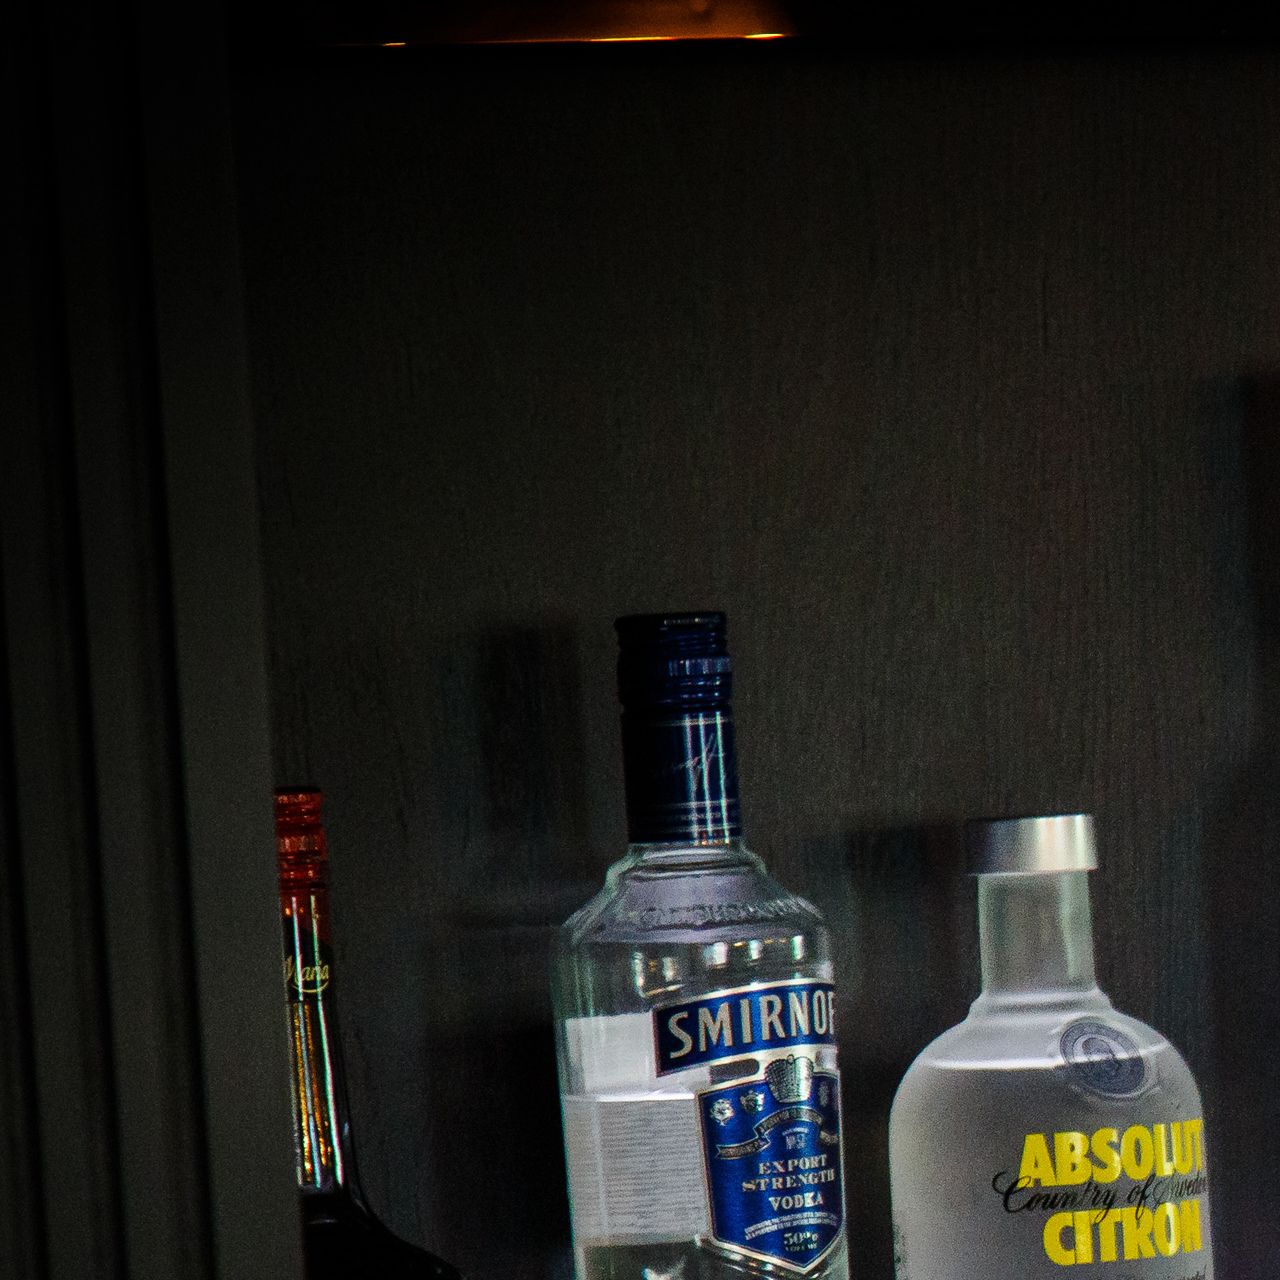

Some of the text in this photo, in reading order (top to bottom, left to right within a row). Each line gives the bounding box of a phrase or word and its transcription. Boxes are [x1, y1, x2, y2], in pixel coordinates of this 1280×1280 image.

[758, 1154, 828, 1175] EXPORT
[1016, 1119, 1203, 1188] ABSOLUT
[742, 1168, 836, 1192] STRENGTH
[992, 1172, 1114, 1223] Country
[1127, 1174, 1157, 1221] of
[769, 1192, 824, 1211] VODKA
[1043, 1199, 1203, 1266] CITRON
